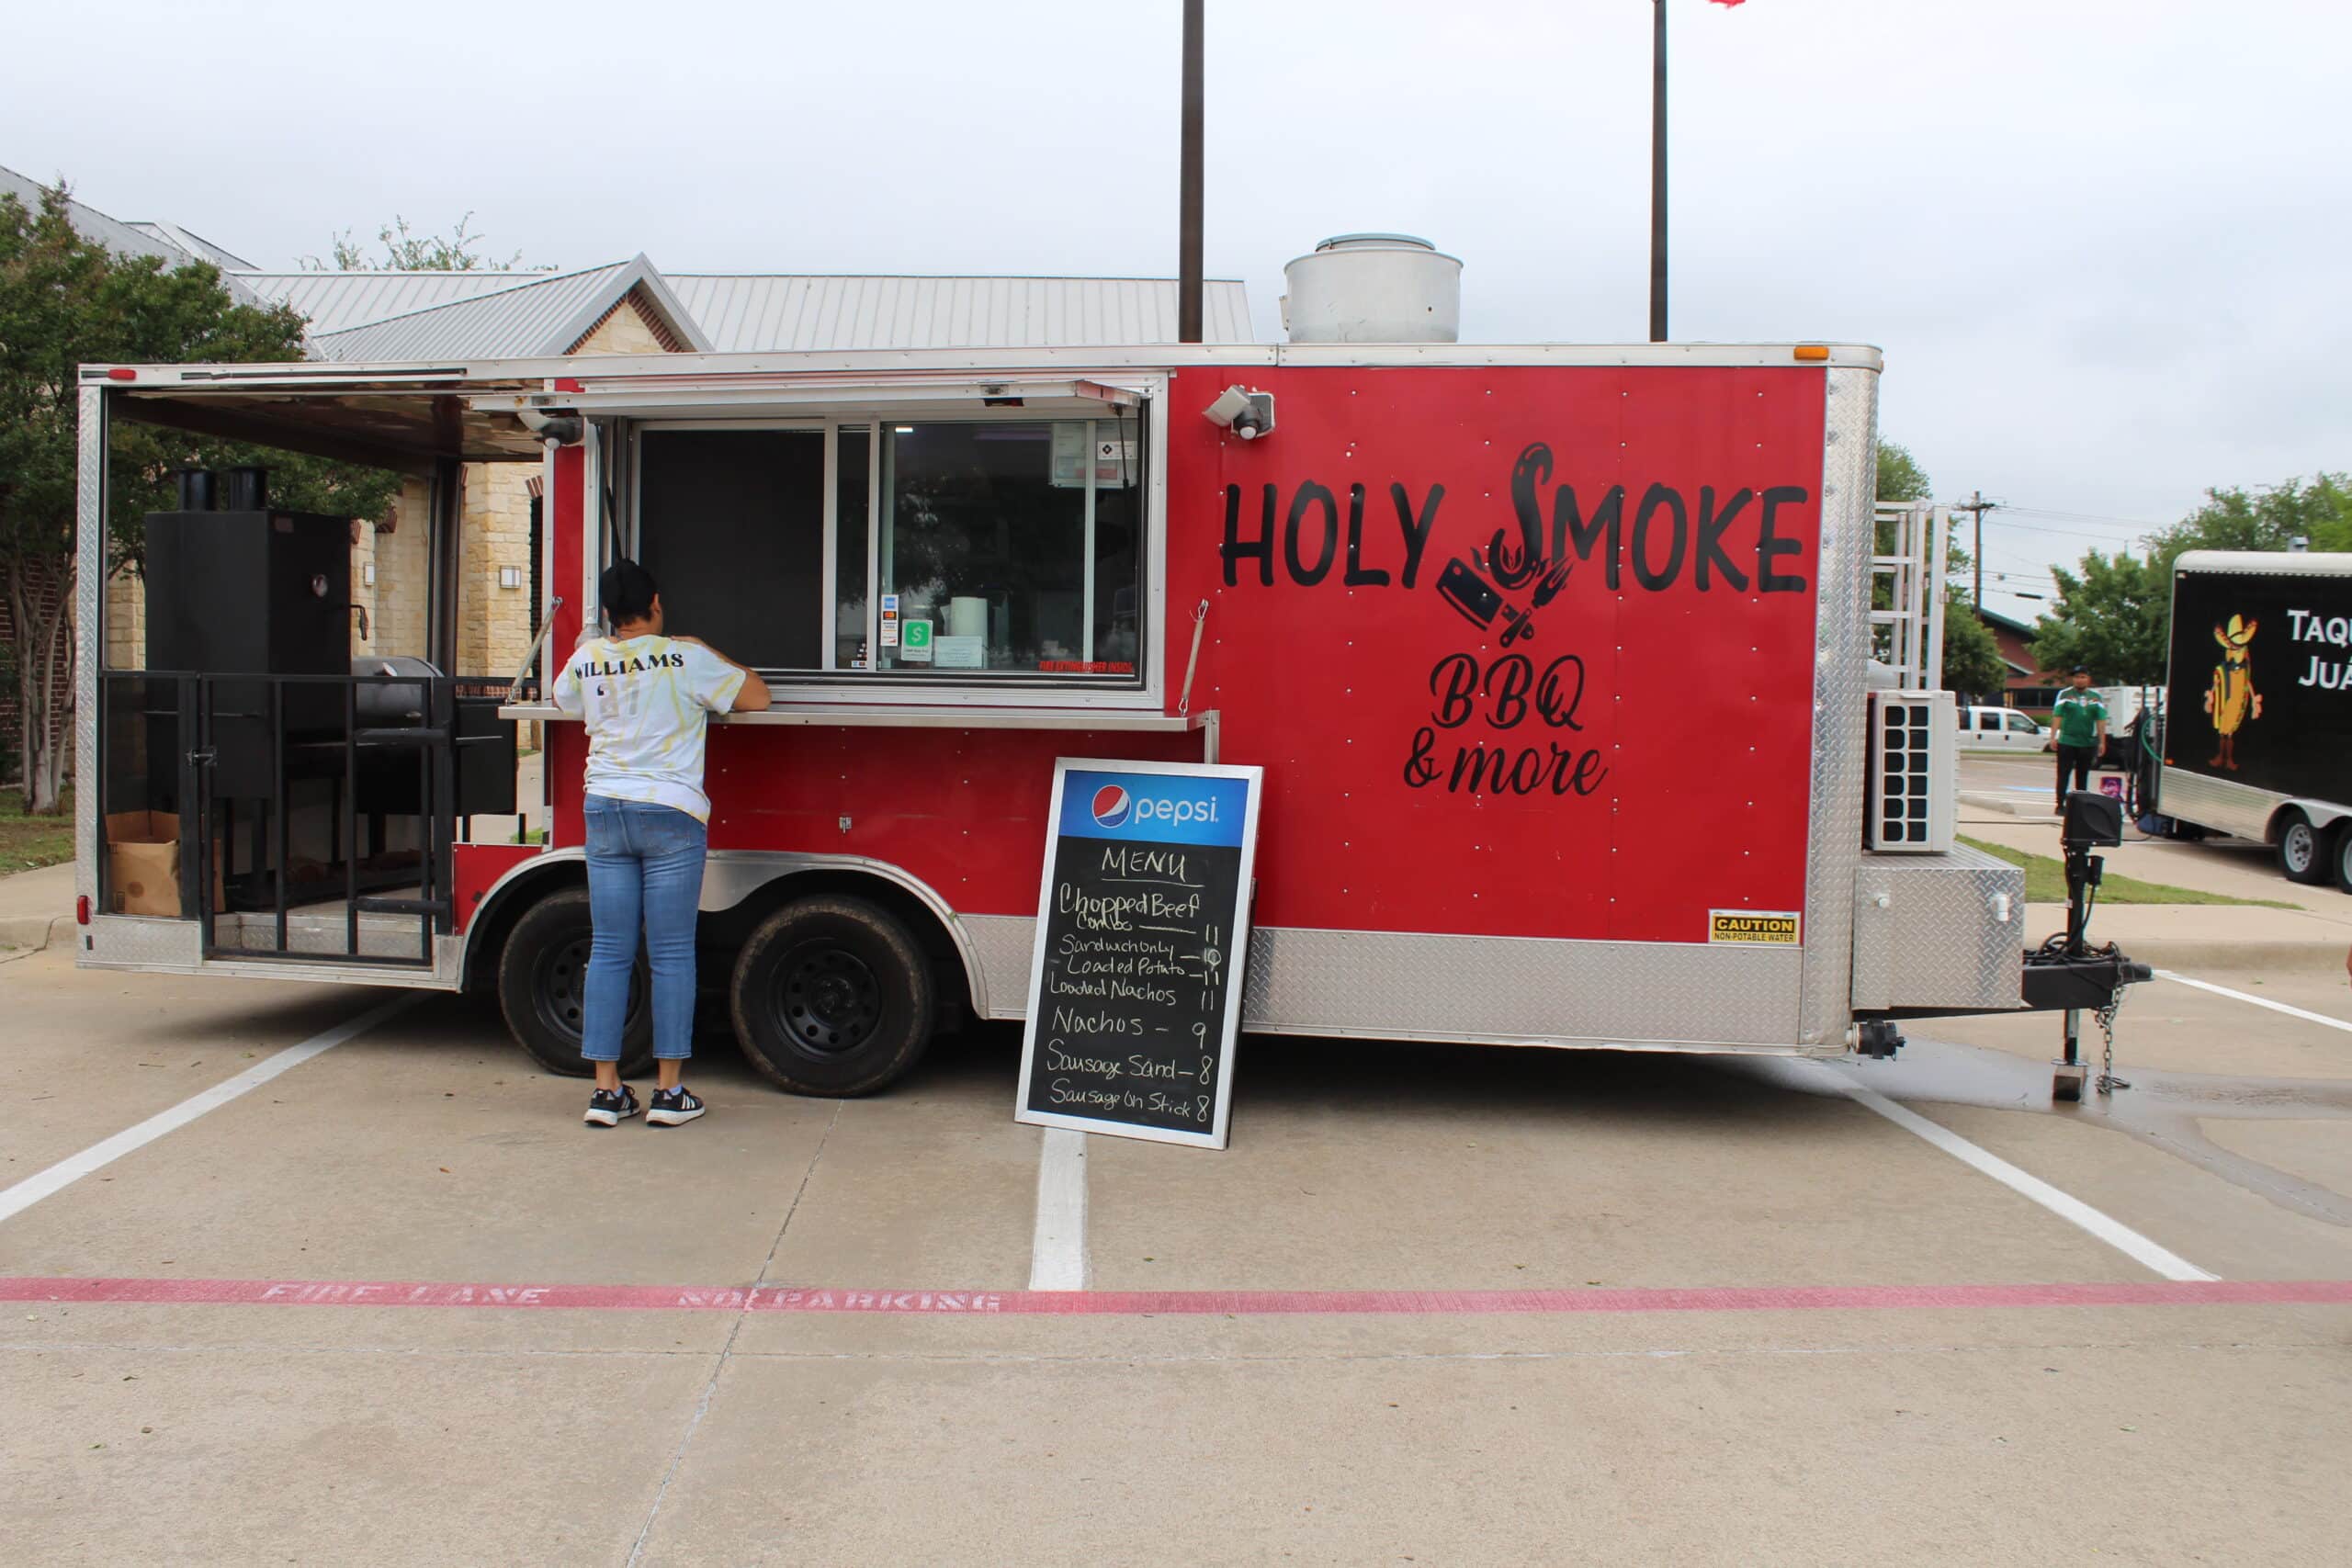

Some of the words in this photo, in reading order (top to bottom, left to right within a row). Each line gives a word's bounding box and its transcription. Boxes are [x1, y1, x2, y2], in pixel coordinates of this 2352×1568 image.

[1219, 479, 1445, 590] HOLY
[1487, 441, 1808, 593] SMOKE
[2286, 608, 2352, 649] TAQ
[1430, 653, 1585, 731] BBQ
[1403, 728, 1444, 788] &
[1447, 741, 1609, 796] more
[1135, 795, 1217, 827] pepsi
[1102, 846, 1186, 883] MENU
[1060, 883, 1148, 925] Chopped
[1151, 893, 1200, 919] Beef
[1058, 933, 1137, 955] Sandwich
[1077, 910, 1133, 931] Combo
[1205, 923, 1218, 945] 11
[1714, 931, 1766, 942] NON-POTABLE
[1768, 933, 1794, 942] WATER
[1716, 919, 1793, 931] CAUTION
[1050, 970, 1106, 997] Loaded
[1110, 979, 1177, 1006] Nachos
[1201, 989, 1214, 1011] 11
[1068, 954, 1134, 975] Loaded
[1204, 970, 1219, 987] 11
[1052, 1006, 1144, 1035] Nachos
[1192, 1021, 1206, 1050] 9
[1046, 1038, 1124, 1080] Sausage
[1128, 1054, 1175, 1080] Sand
[1199, 1055, 1213, 1085] 8
[1049, 1077, 1120, 1111] Sausage
[1148, 1092, 1191, 1118] Stick
[1197, 1095, 1210, 1122] 8
[772, 1292, 1001, 1312] PARKING
